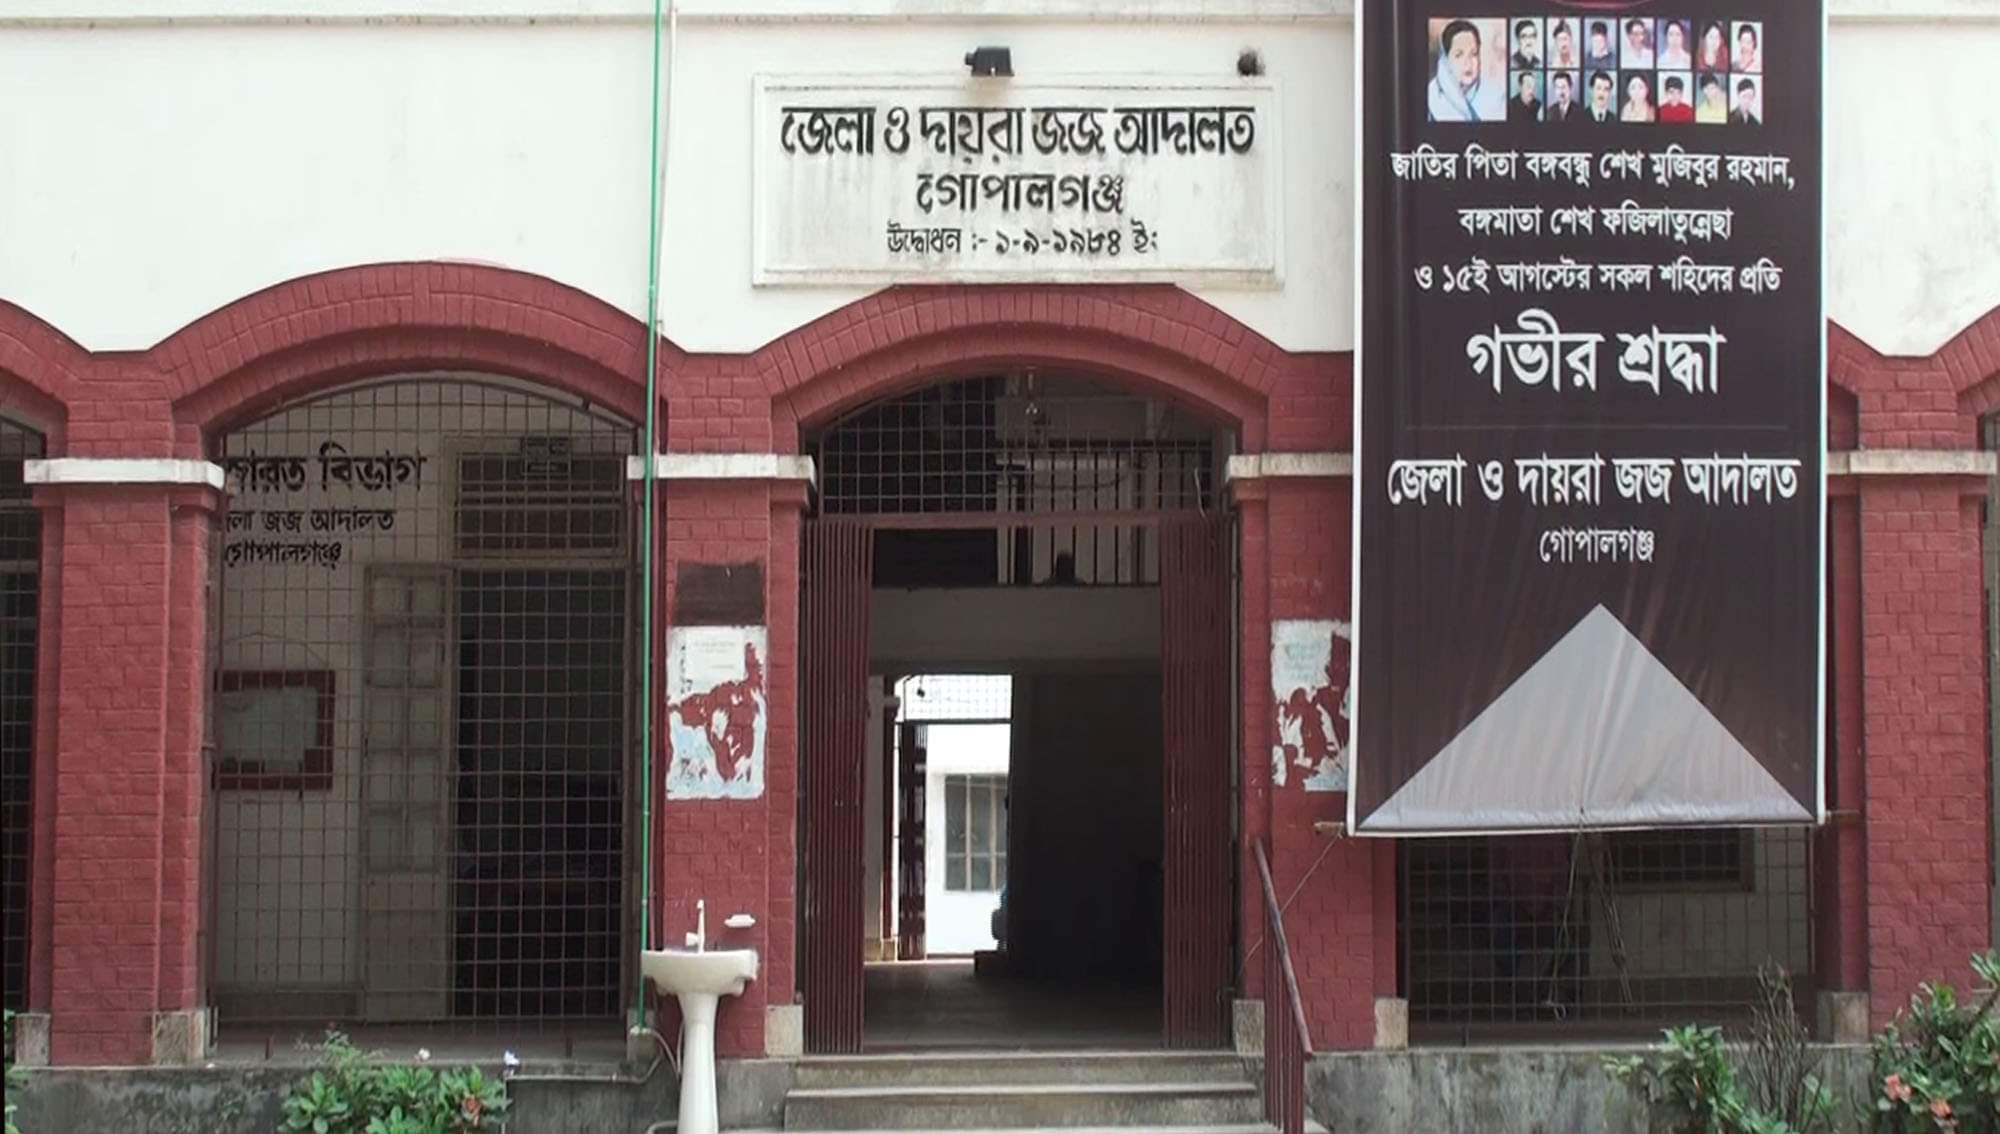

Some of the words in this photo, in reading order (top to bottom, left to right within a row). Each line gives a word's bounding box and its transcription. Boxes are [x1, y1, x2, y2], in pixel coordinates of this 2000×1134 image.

[781, 106, 877, 156] জেলা
[883, 106, 911, 154] ও
[919, 106, 1026, 164] দায়রা
[1031, 106, 1108, 155] জজ
[1112, 106, 1256, 156] আদালত
[1391, 144, 1459, 180] জাতির
[1464, 144, 1518, 180] পিতা
[1524, 151, 1593, 188] বঙ্গবন্ধু
[1599, 149, 1645, 180] শেখ
[1650, 144, 1721, 188] মুজিবুর
[1725, 154, 1796, 190] রহমান,
[916, 173, 1125, 215] গোপালগঞ্জ
[1457, 205, 1544, 236] বঙ্গমাতা
[1550, 205, 1596, 236] শেখ
[1601, 198, 1735, 244] ফজিলাতুন্নেছা
[1413, 263, 1433, 290] ও
[1442, 256, 1491, 294] ১৫ই
[1496, 255, 1593, 292] আগস্টের
[1598, 264, 1654, 292] সকল
[1658, 255, 1735, 296] শহিদের
[1739, 257, 1784, 294] প্রতি
[1466, 308, 1606, 394] গভীর
[1616, 325, 1728, 395] শ্রদ্ধা
[319, 441, 428, 492] বিভাগ
[1387, 453, 1468, 506] জেলা
[1476, 459, 1505, 502] ও
[1513, 452, 1606, 506] দায়রা
[1611, 457, 1676, 504] জজ
[1681, 452, 1802, 506] আদালত
[261, 510, 306, 534] জজ
[310, 506, 397, 534] আদালত
[1538, 525, 1656, 564] গোপালগঞ্জ
